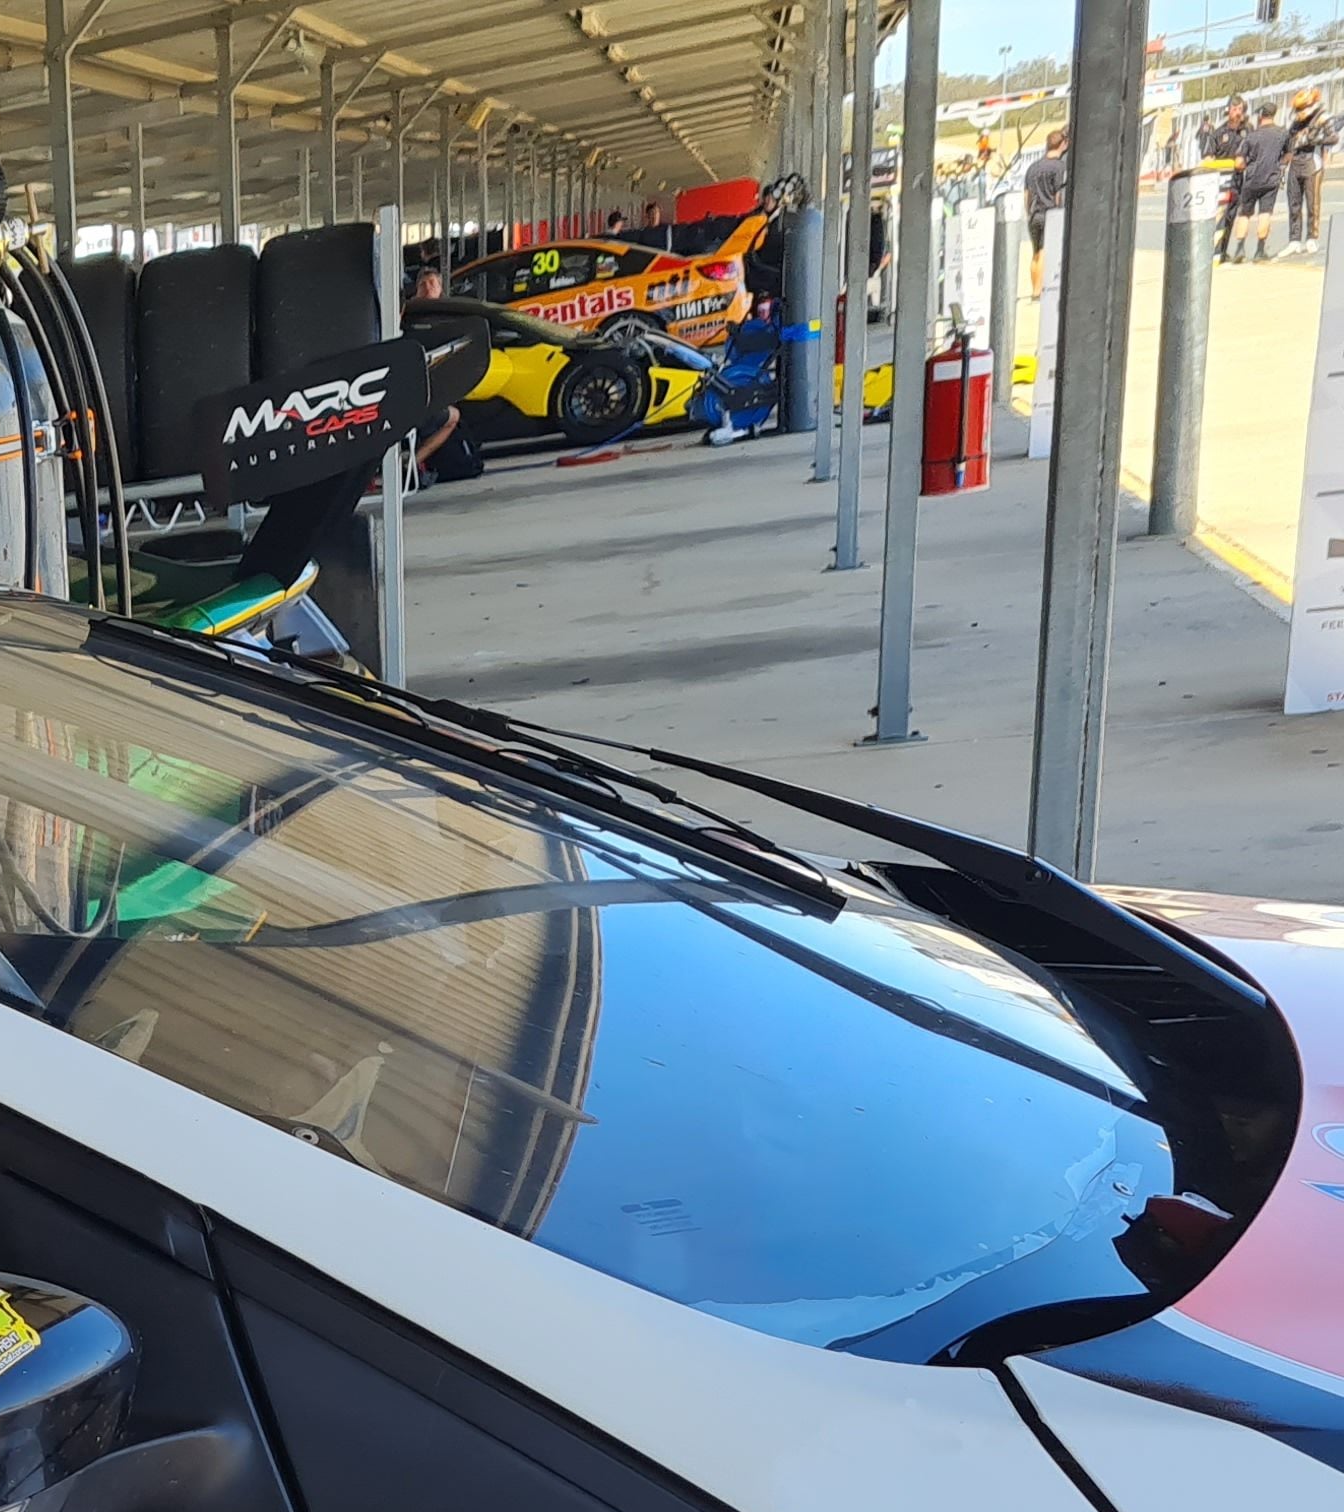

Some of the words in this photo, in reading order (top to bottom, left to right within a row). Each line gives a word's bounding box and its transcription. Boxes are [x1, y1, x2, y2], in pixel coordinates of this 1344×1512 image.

[1183, 191, 1205, 208] 25
[533, 250, 559, 276] 30
[223, 366, 390, 444] MARC
[305, 404, 379, 437] CARS
[229, 420, 392, 472] AUSTRALIA
